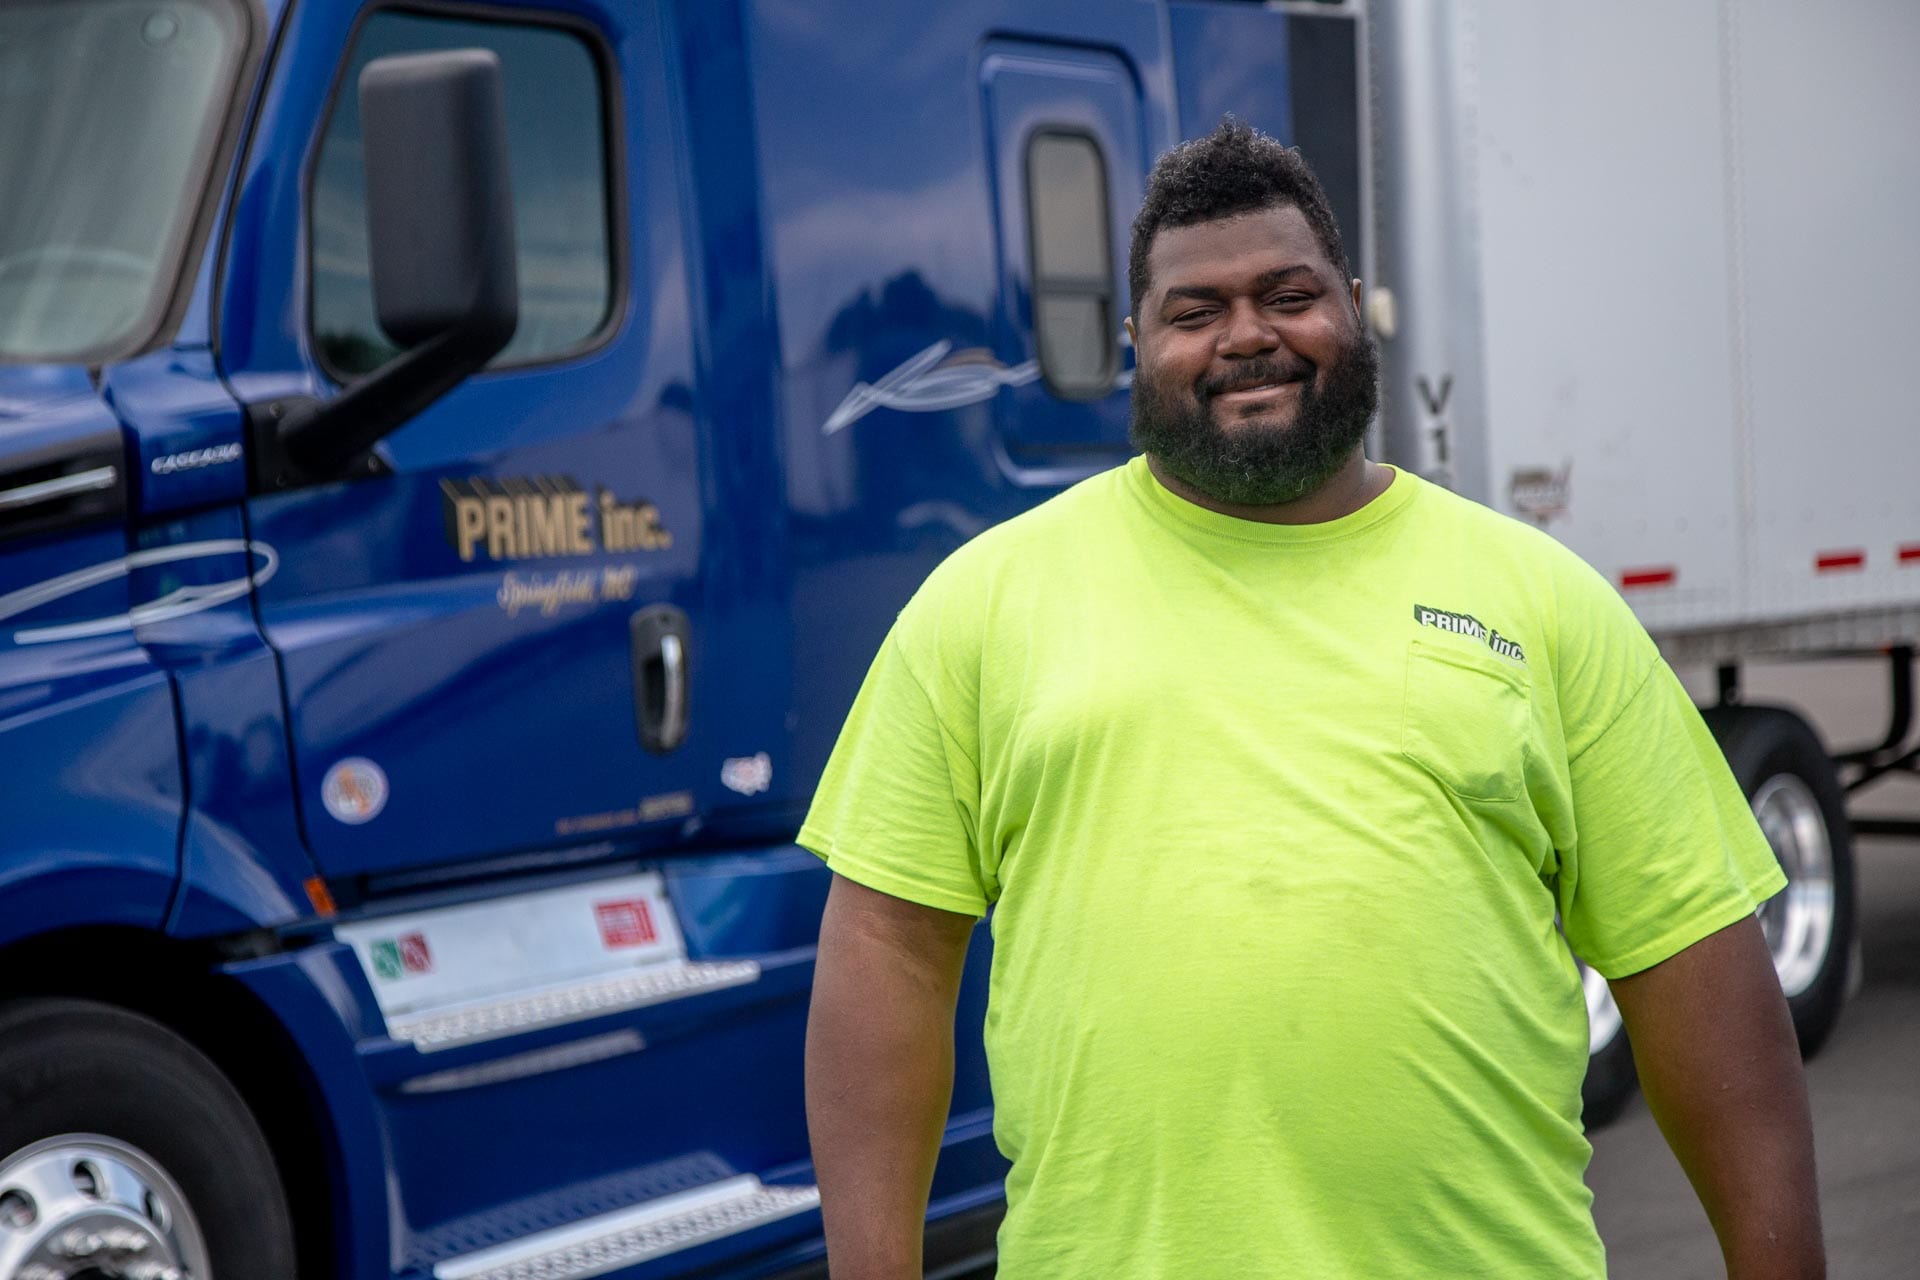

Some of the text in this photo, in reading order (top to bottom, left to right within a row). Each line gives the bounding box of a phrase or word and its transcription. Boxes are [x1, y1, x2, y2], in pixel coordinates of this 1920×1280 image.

[453, 489, 673, 562] PRIME inc.
[1417, 607, 1527, 664] PRIME inc.
